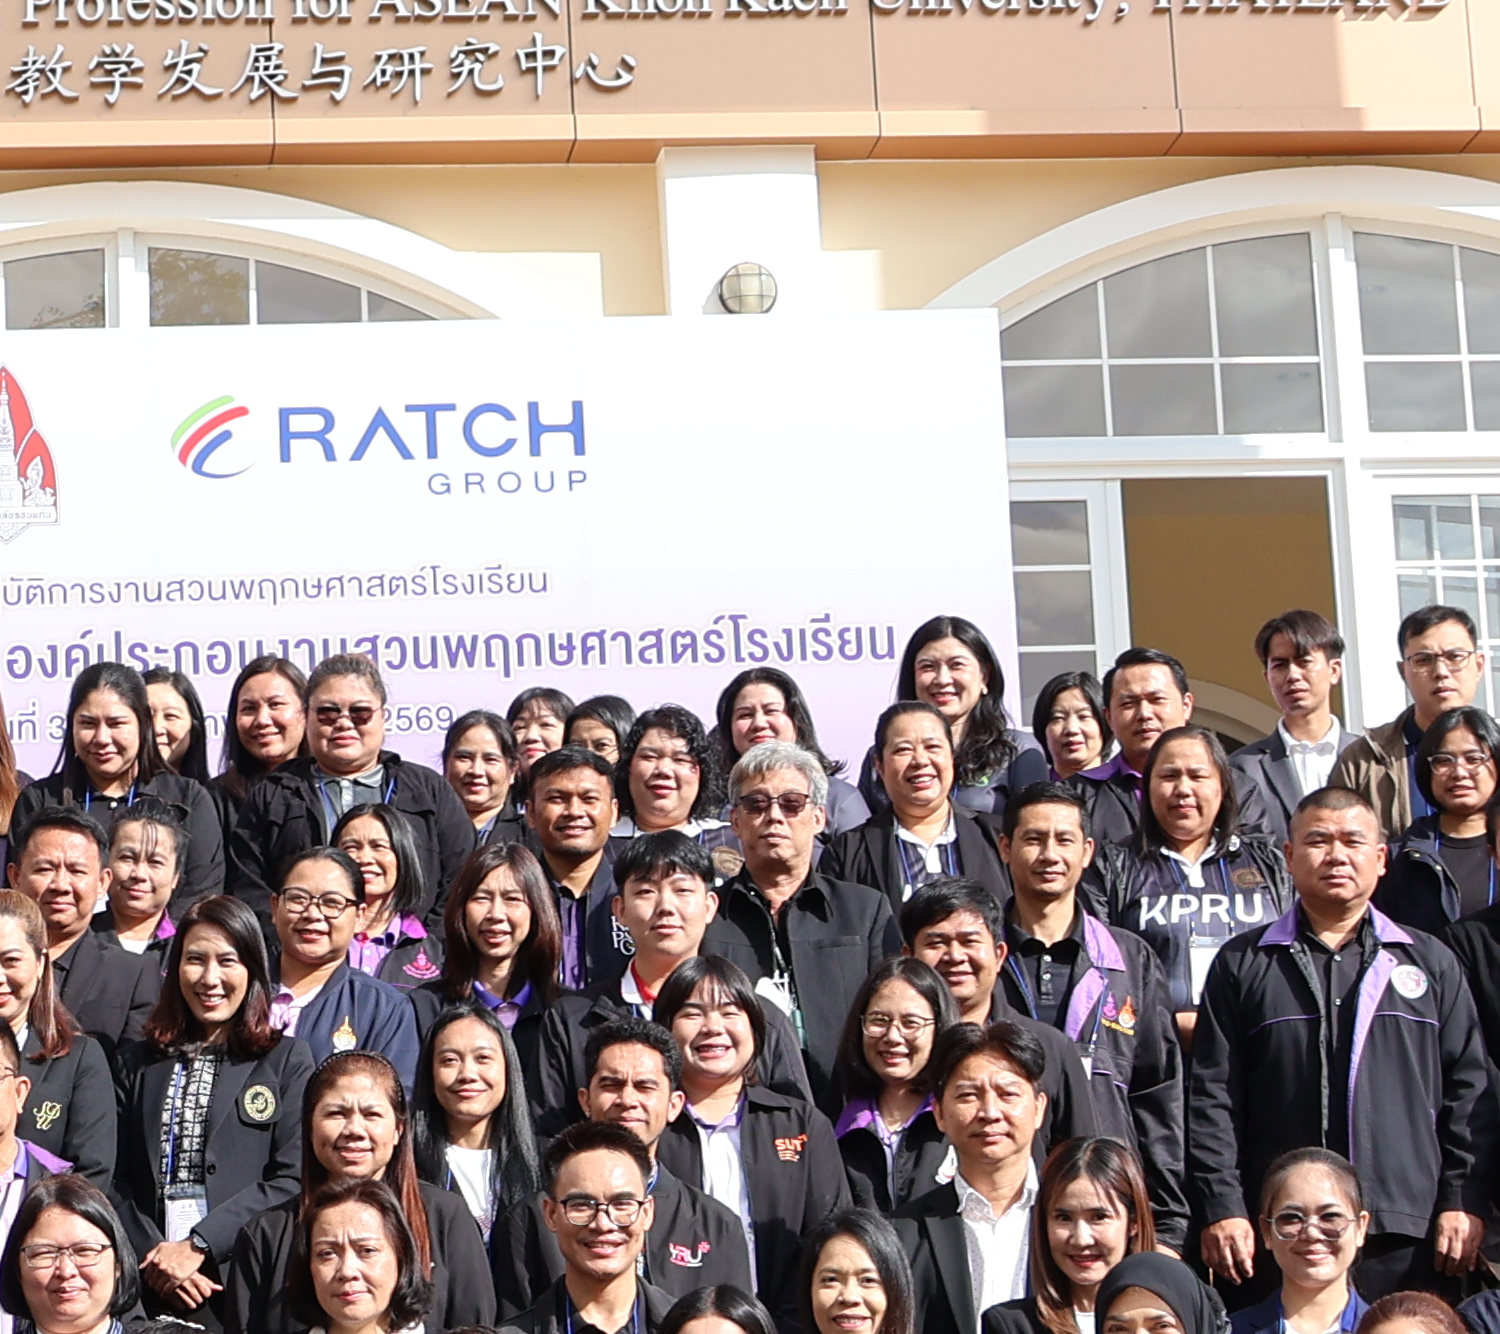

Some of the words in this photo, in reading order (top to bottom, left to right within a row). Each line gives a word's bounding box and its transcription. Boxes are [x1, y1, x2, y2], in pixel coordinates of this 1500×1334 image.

[278, 400, 586, 463] RATCH
[427, 470, 588, 495] GROUP
[384, 705, 453, 733] 2569
[1139, 893, 1264, 927] KPRU
